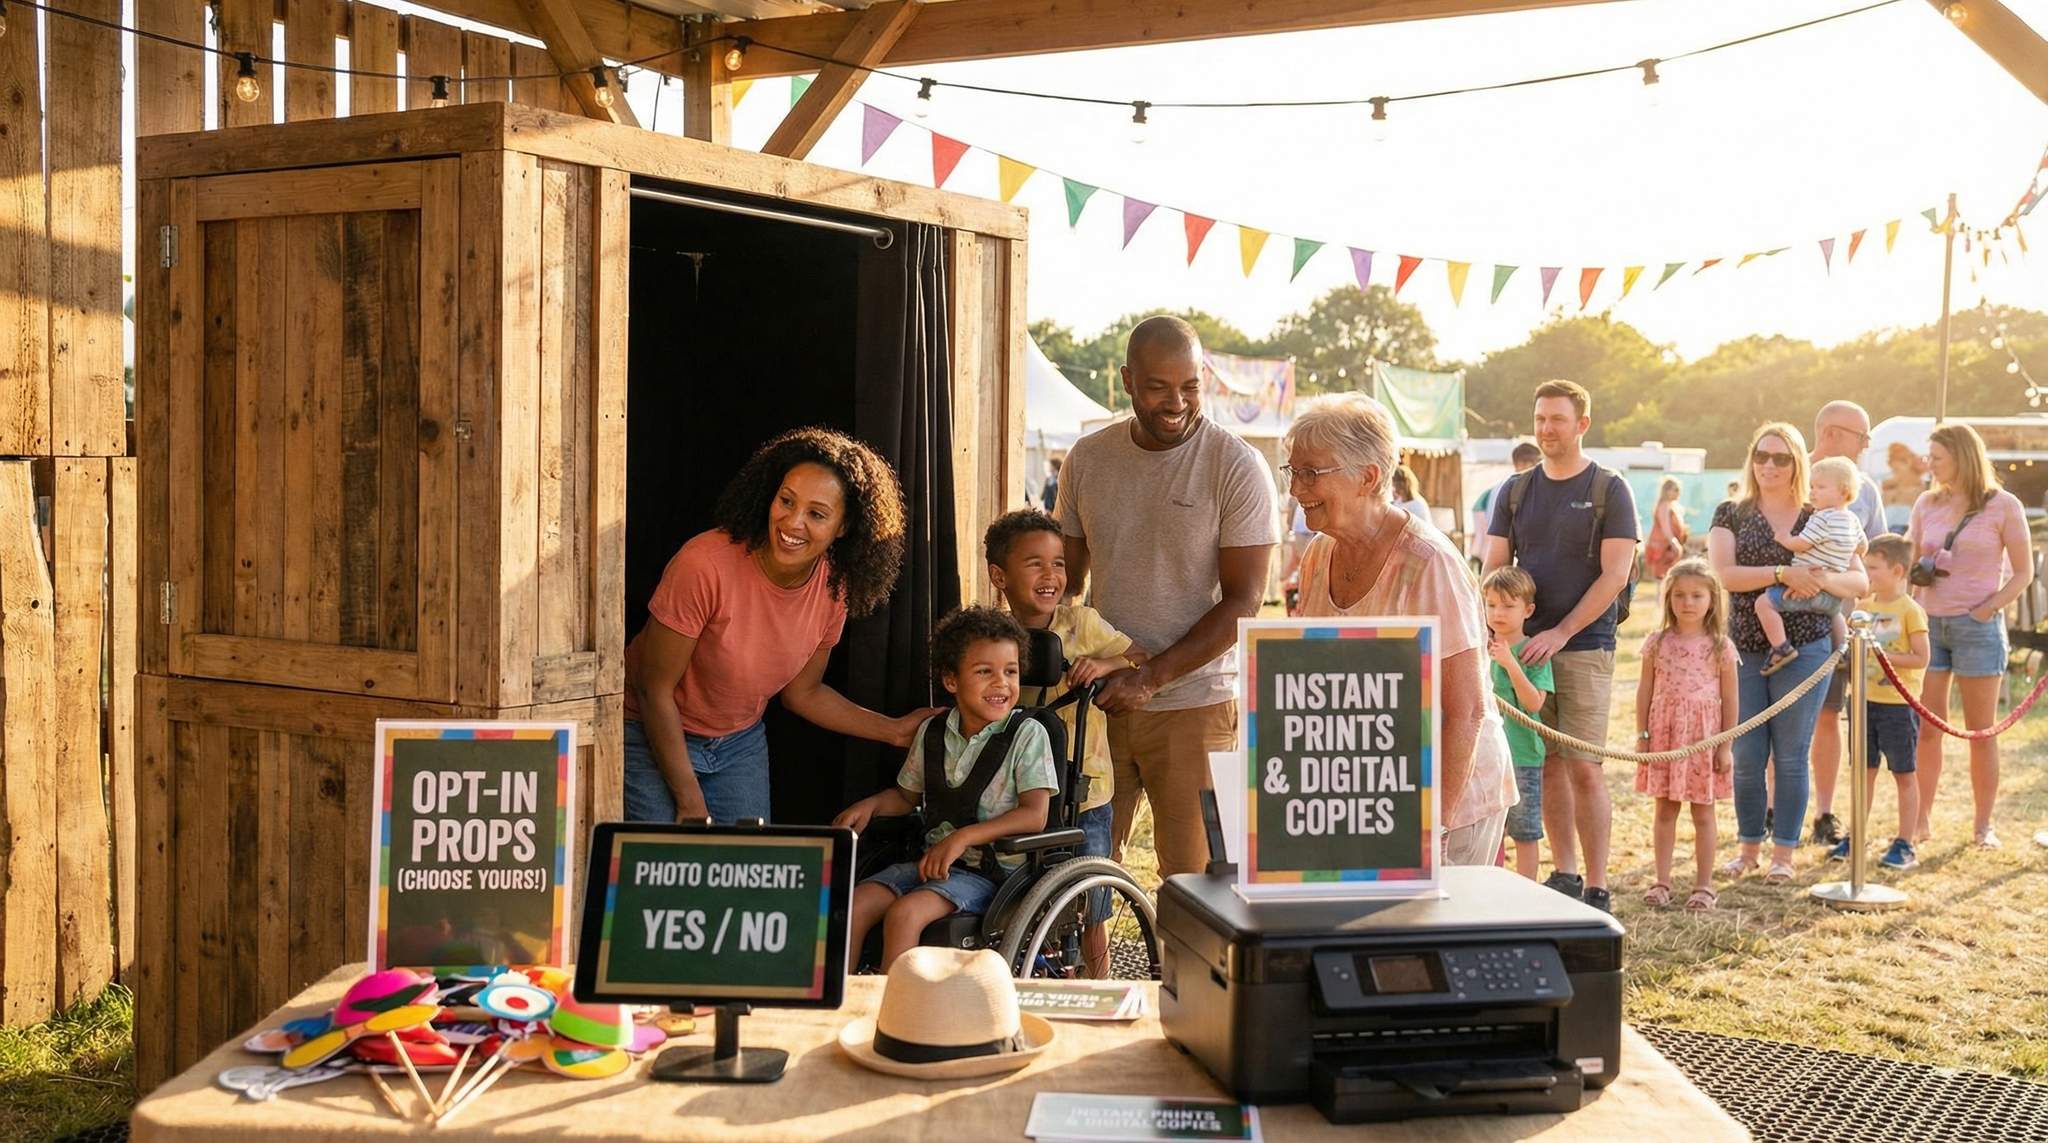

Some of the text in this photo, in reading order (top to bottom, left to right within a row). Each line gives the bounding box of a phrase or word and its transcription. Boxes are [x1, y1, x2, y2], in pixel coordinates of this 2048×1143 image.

[1275, 672, 1404, 710] INSTANT
[1284, 714, 1395, 752] PRINTS
[412, 770, 538, 815] OPT-IN
[1263, 756, 1416, 795] & DIGITAL
[1285, 797, 1395, 836] COPIES
[411, 818, 536, 863] PROPS
[397, 867, 547, 893] (CHOOSE YOURS!)
[634, 861, 805, 889] PHOTO CONSENT:
[642, 908, 788, 955] YES / NO
[1151, 1108, 1217, 1121] PRINTS
[1156, 1119, 1222, 1132] COPIES
